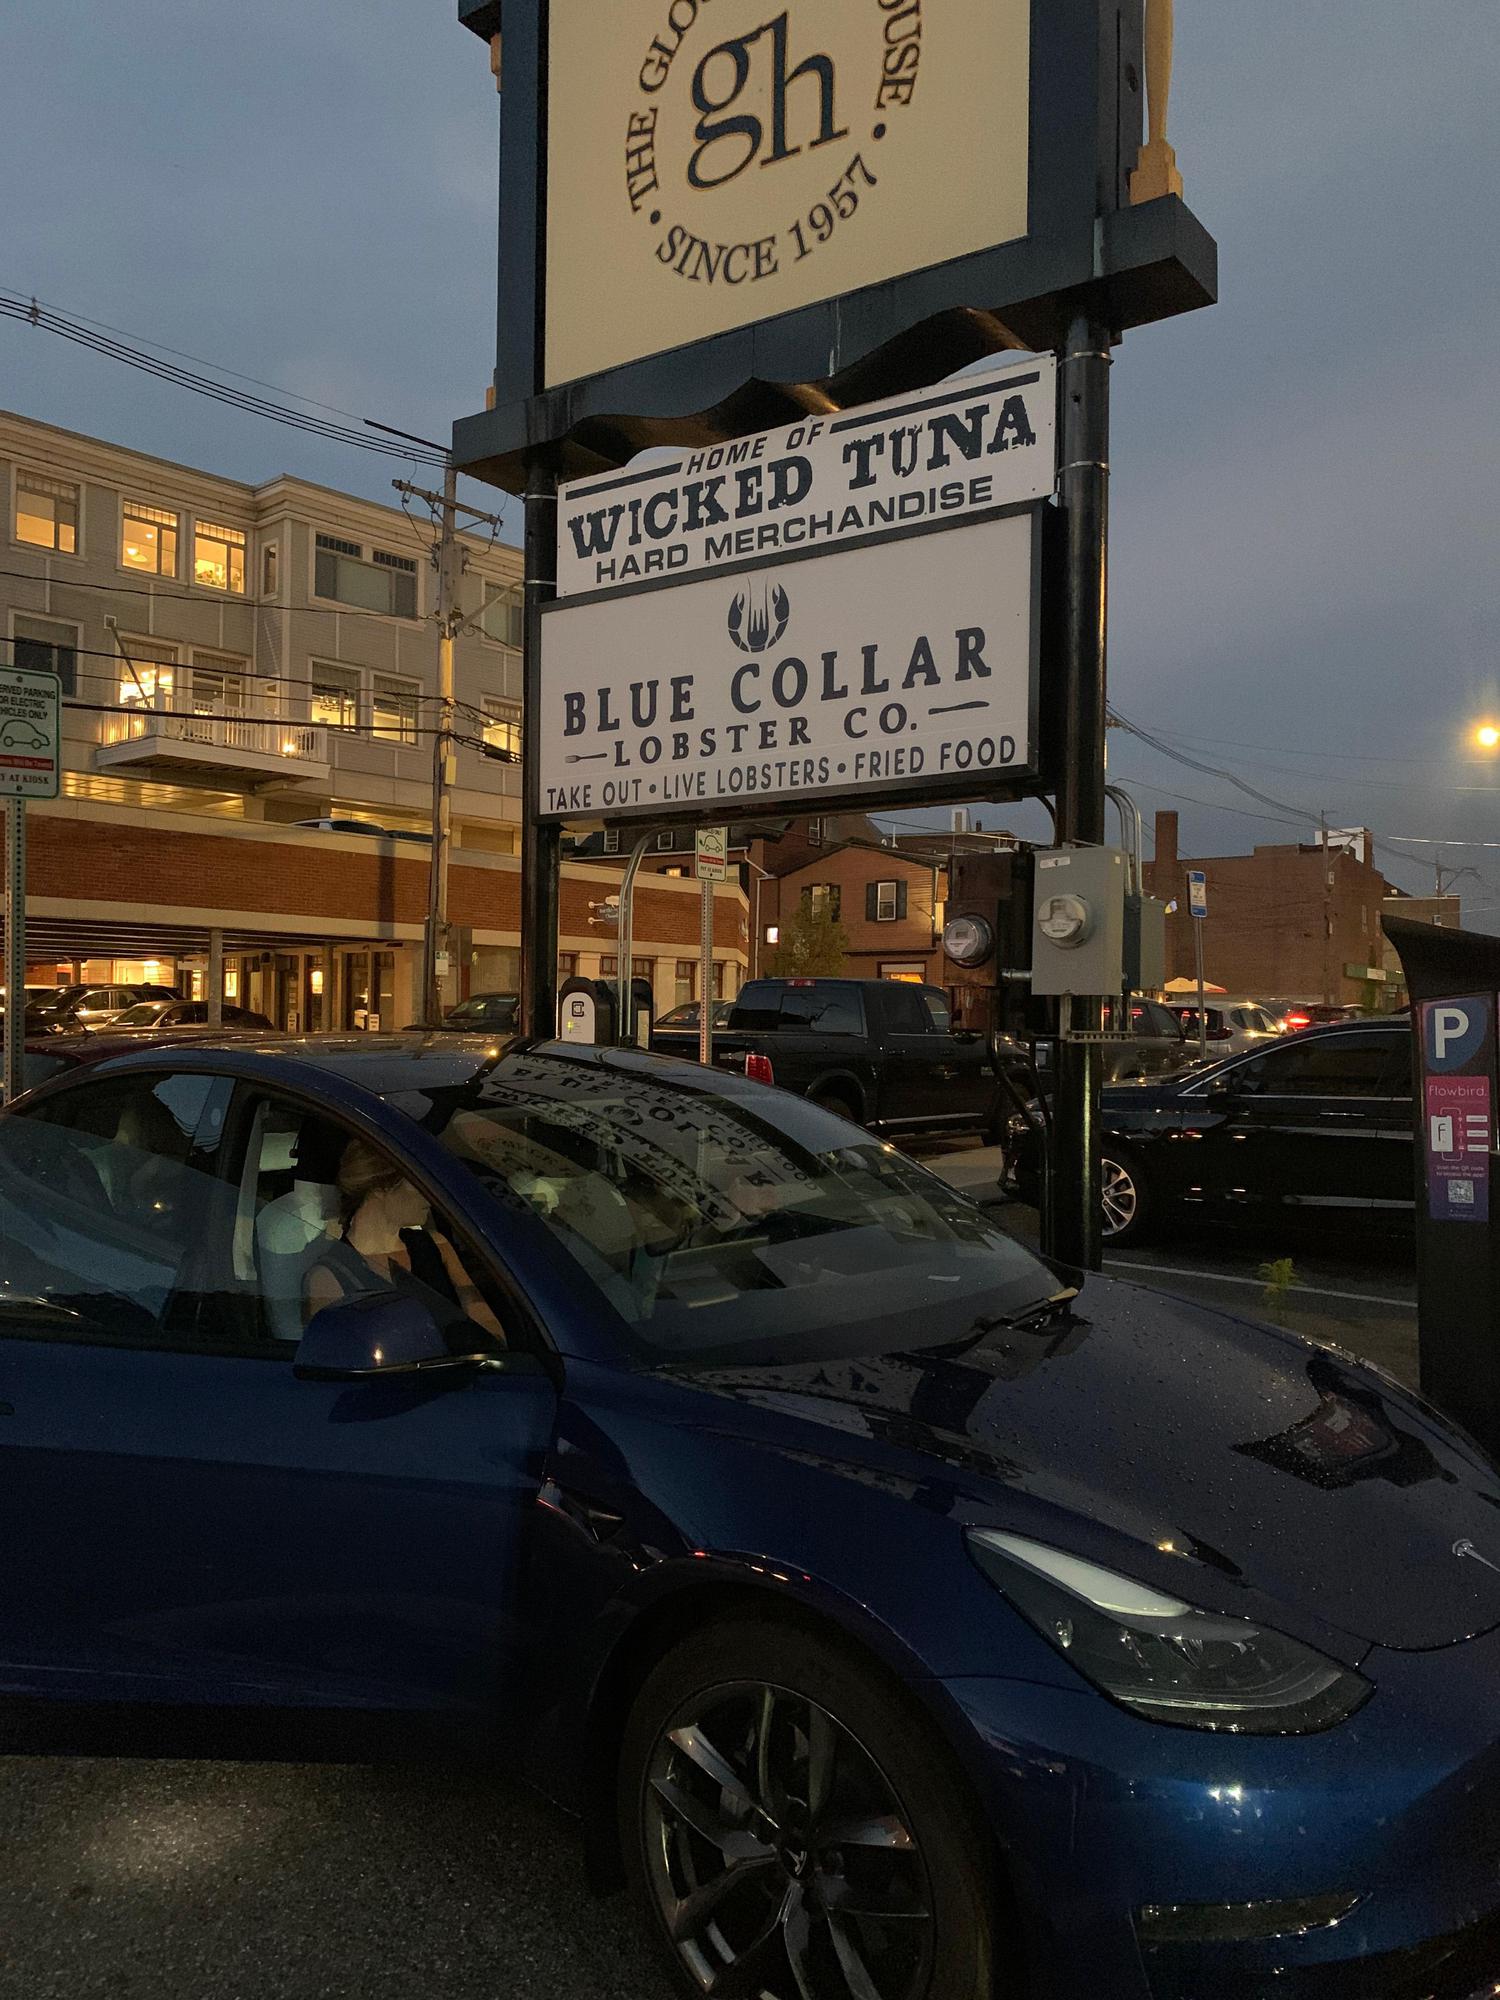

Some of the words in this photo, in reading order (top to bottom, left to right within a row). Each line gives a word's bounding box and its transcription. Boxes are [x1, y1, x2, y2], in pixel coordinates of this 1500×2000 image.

[687, 11, 848, 190] gh
[626, 107, 659, 214] THE
[655, 224, 779, 284] SINCE
[788, 152, 878, 262] 1957
[567, 455, 813, 560] WICKED
[842, 393, 1037, 491] TUNA
[685, 437, 766, 476] HOME
[786, 421, 825, 451] OF
[596, 541, 689, 584] HARD
[704, 475, 994, 562] MERCHANDISE
[11, 697, 45, 709] ELECTRIC
[29, 710, 48, 720] ONLY
[563, 674, 695, 737] BLUE
[730, 626, 992, 714] COLLAR
[547, 783, 592, 812] TAKE
[602, 778, 642, 806] OUT
[663, 770, 706, 801] LIVE
[717, 755, 831, 795] LOBSTERS
[854, 745, 924, 780] FRIED
[940, 735, 1016, 772] FOOD
[614, 716, 812, 767] LOBSTER
[843, 702, 918, 739] CO.
[1434, 1008, 1470, 1059] P
